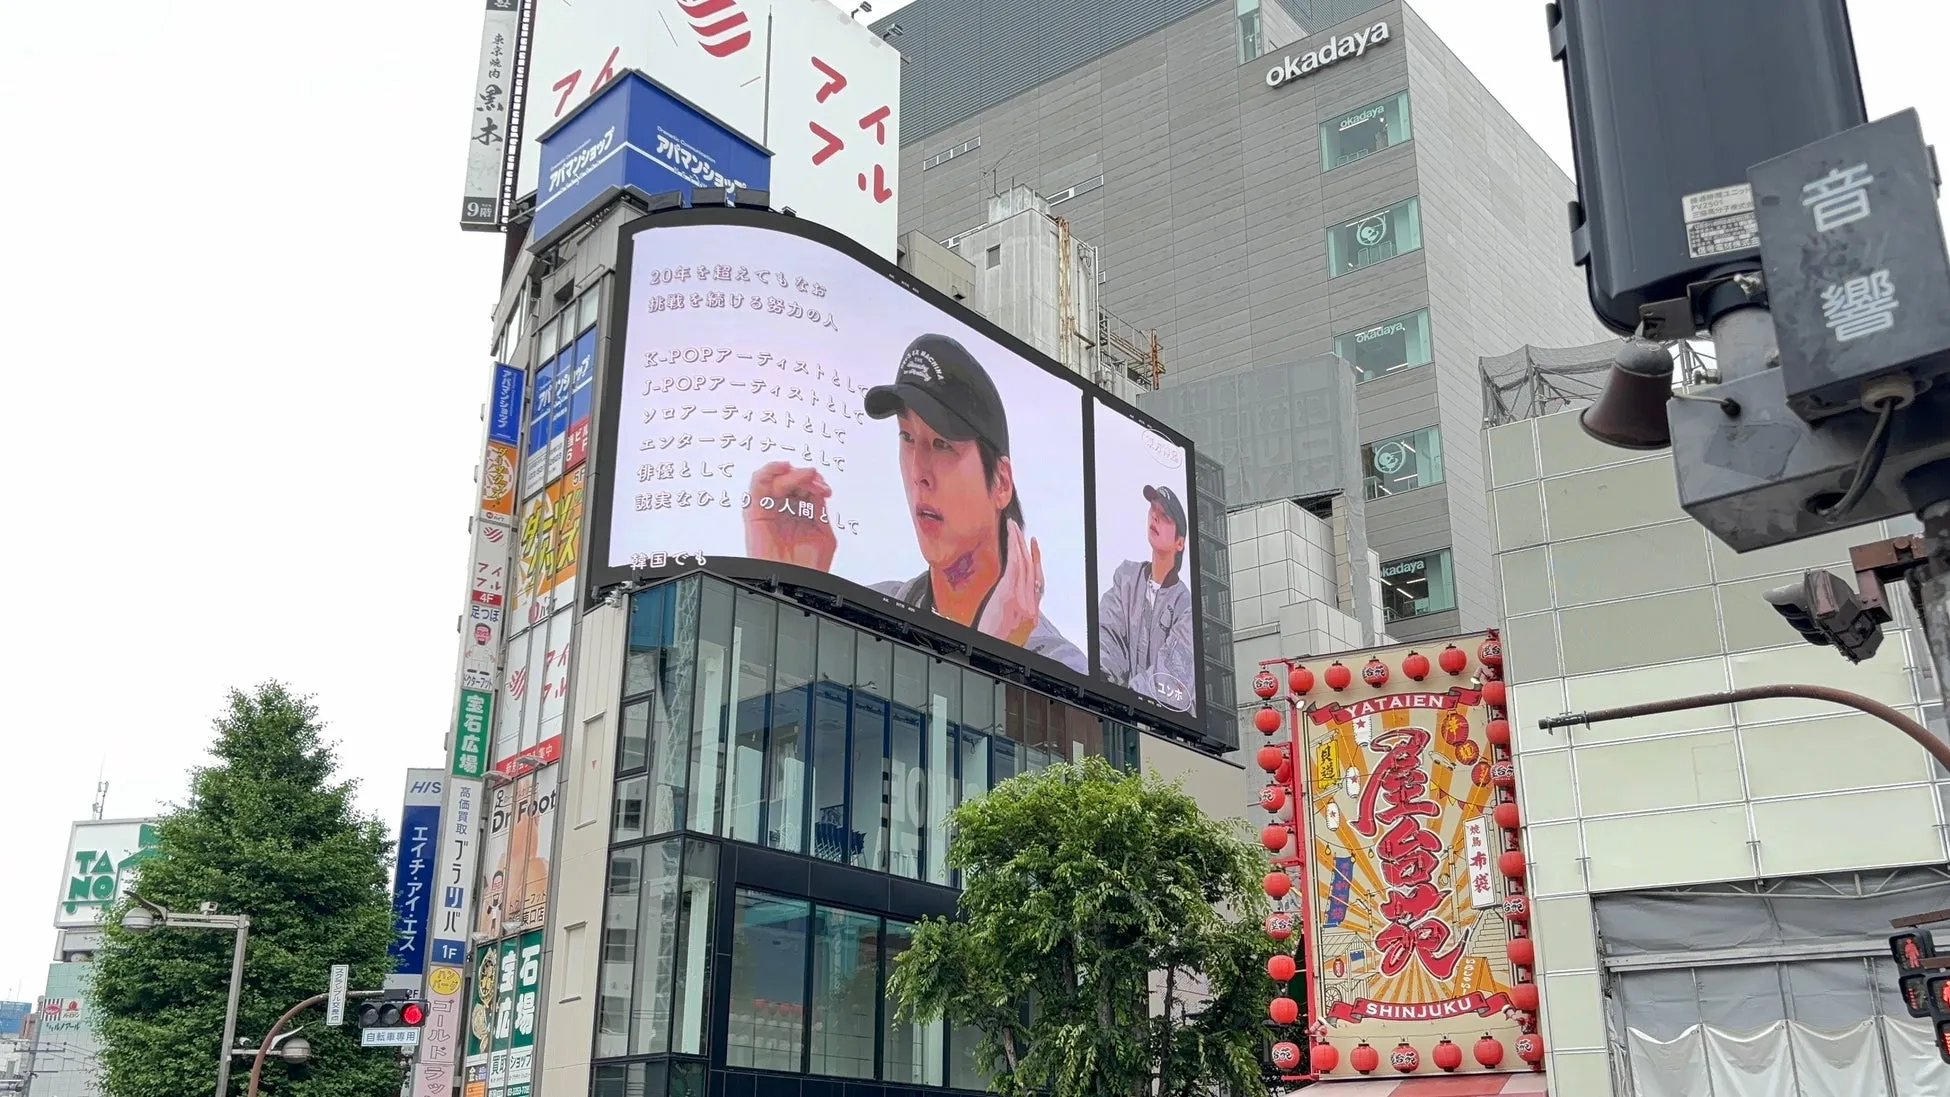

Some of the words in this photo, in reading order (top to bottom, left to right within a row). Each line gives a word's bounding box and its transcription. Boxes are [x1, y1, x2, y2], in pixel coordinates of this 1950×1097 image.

[489, 33, 504, 79] 東京焼肉
[1265, 22, 1389, 86] okadaya
[472, 84, 503, 145] 黒木
[1340, 104, 1384, 129] okadaya
[549, 126, 615, 193] アパマンショップ
[466, 202, 492, 218] 9階
[1802, 162, 1899, 342] 音響
[649, 264, 827, 298] 20年を超えてもなお
[648, 291, 839, 332] 挑戦を続ける努力の人
[1356, 322, 1402, 343] okadaya
[643, 404, 846, 444] ソロアーティストとして
[637, 461, 735, 482] 俳優として
[640, 433, 846, 472] エンターテイナーとして
[635, 490, 859, 535] 誠実なひとりの人間として
[630, 550, 707, 570] 韓国でも
[480, 593, 494, 603] 4F
[1158, 682, 1183, 701] ユンホ
[1346, 695, 1444, 719] YATAIEN
[459, 694, 485, 775] 宝石広場
[410, 781, 441, 795] HIS
[456, 786, 471, 835] 高価買取
[491, 810, 512, 833] Dr
[517, 790, 556, 824] Foot
[1350, 728, 1471, 980] 屋台苑
[444, 839, 469, 932] ブラリバ
[442, 944, 457, 959] 1F
[1366, 997, 1472, 1019] SHINJUKU
[366, 1031, 416, 1042] 自転車専用
[424, 999, 455, 1097] ゴールドラッ
